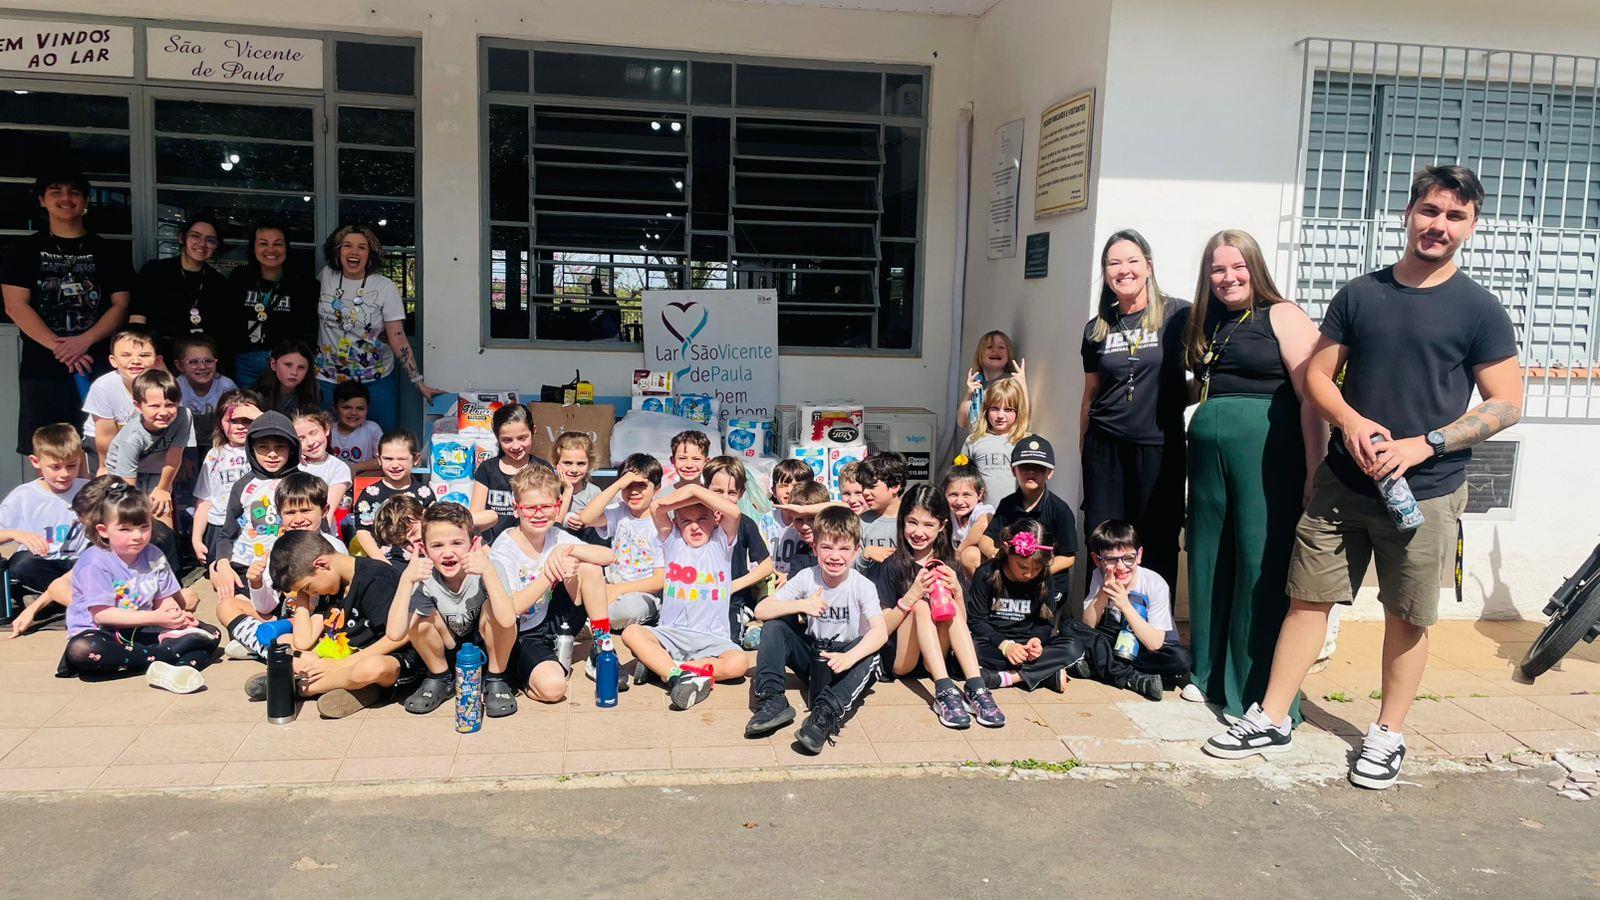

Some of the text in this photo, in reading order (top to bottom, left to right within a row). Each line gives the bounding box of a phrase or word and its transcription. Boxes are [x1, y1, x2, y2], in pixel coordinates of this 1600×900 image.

[37, 29, 110, 49] VINDOS
[164, 35, 303, 62] São Vicente
[28, 48, 109, 68] AO LAR
[191, 61, 284, 82] de Paulo
[656, 346, 679, 361] Lar
[715, 388, 748, 403] bem
[905, 434, 928, 444] elgin
[985, 453, 1012, 466] IEN
[488, 490, 516, 506] IEN
[870, 538, 898, 548] IEN
